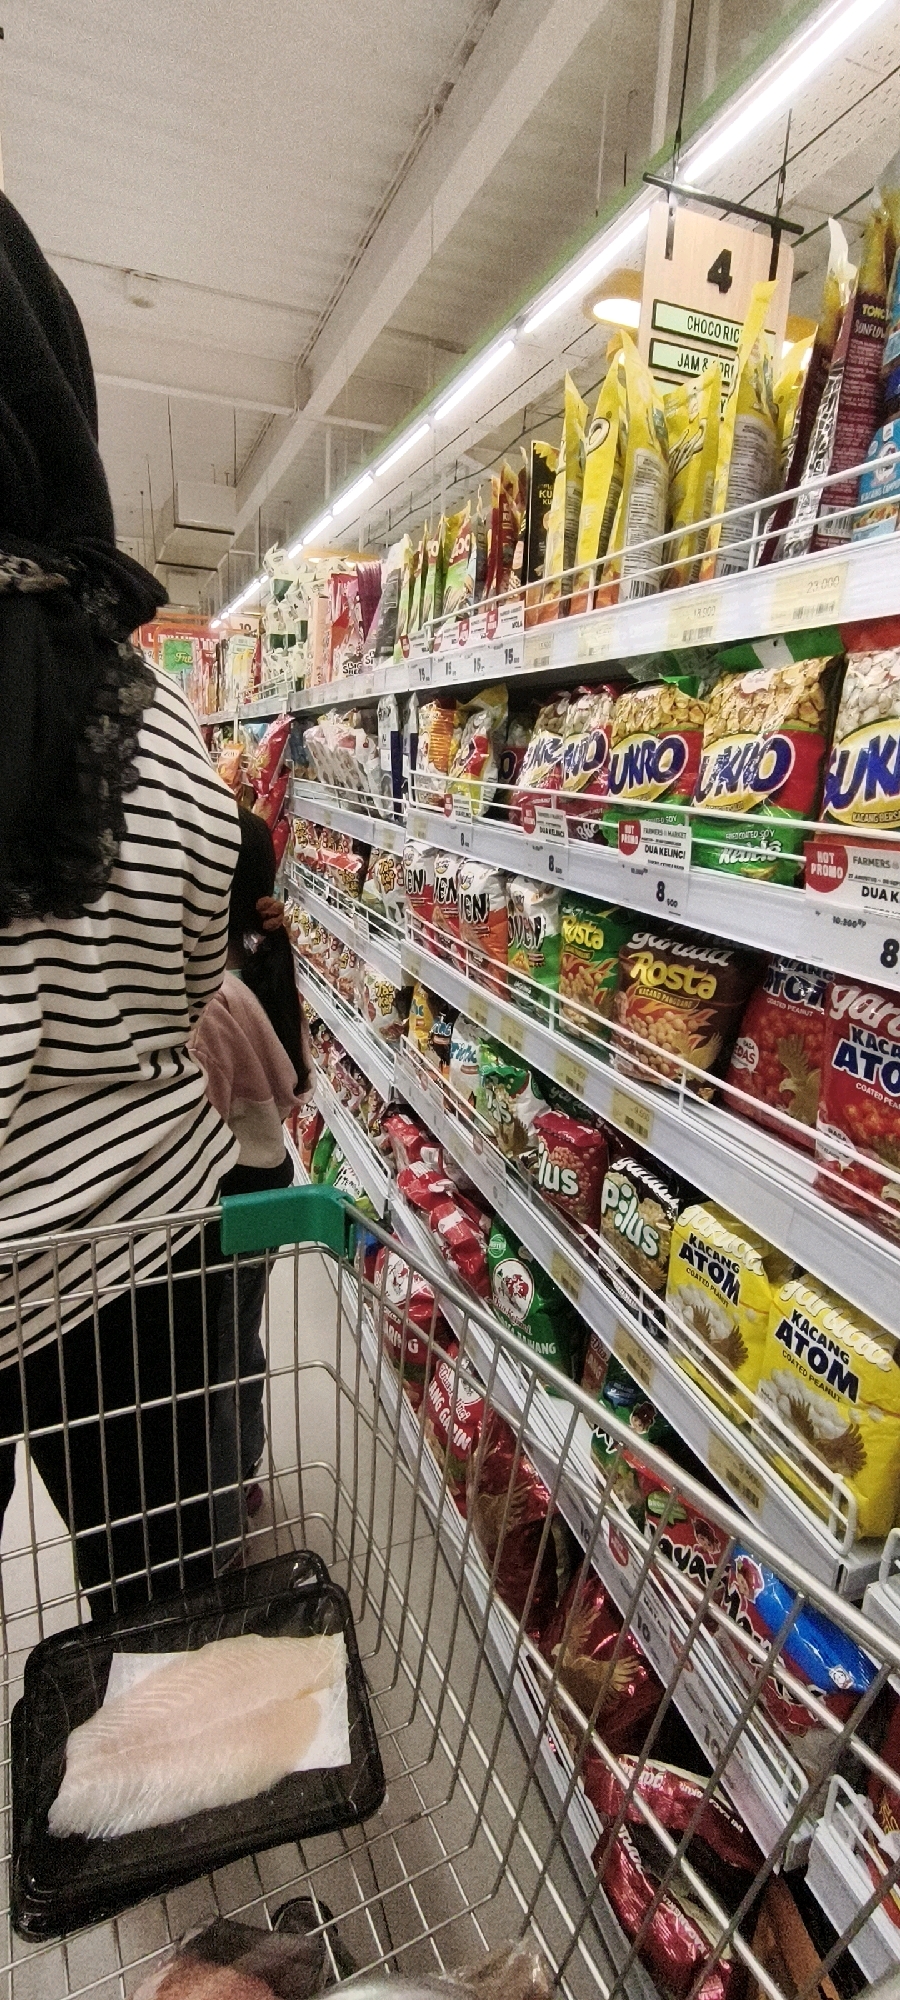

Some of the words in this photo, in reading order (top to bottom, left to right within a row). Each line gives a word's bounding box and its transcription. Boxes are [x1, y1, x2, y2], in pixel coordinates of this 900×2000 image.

[707, 249, 733, 293] 4
[687, 316, 721, 338] CHOCO
[722, 325, 743, 343] RIC
[678, 353, 699, 371] JAM
[505, 648, 514, 665] 15
[852, 812, 879, 824] KACANG
[668, 830, 687, 839] MARKET
[759, 829, 775, 839] SOY
[644, 844, 658, 854] DUA
[659, 847, 686, 860] KELINCI
[816, 851, 834, 865] HOT
[853, 855, 890, 869] FARMERS
[548, 854, 554, 872] 8
[810, 863, 843, 879] PROMO
[656, 881, 665, 902] 8
[861, 885, 887, 902] DUA
[880, 938, 900, 969] 8
[628, 951, 717, 1000] Rosta
[787, 1003, 814, 1017] PEANUT
[856, 1082, 884, 1102] COATED
[601, 1178, 660, 1257] Pilus
[688, 1232, 740, 1275] KACANG
[678, 1242, 742, 1306] ATOM
[685, 1267, 711, 1289] COATED
[709, 1286, 730, 1308] PEANUT
[791, 1308, 850, 1366] KACANG
[774, 1319, 861, 1404] ATOM
[782, 1349, 808, 1378] COATED
[808, 1373, 842, 1404] PEANUT
